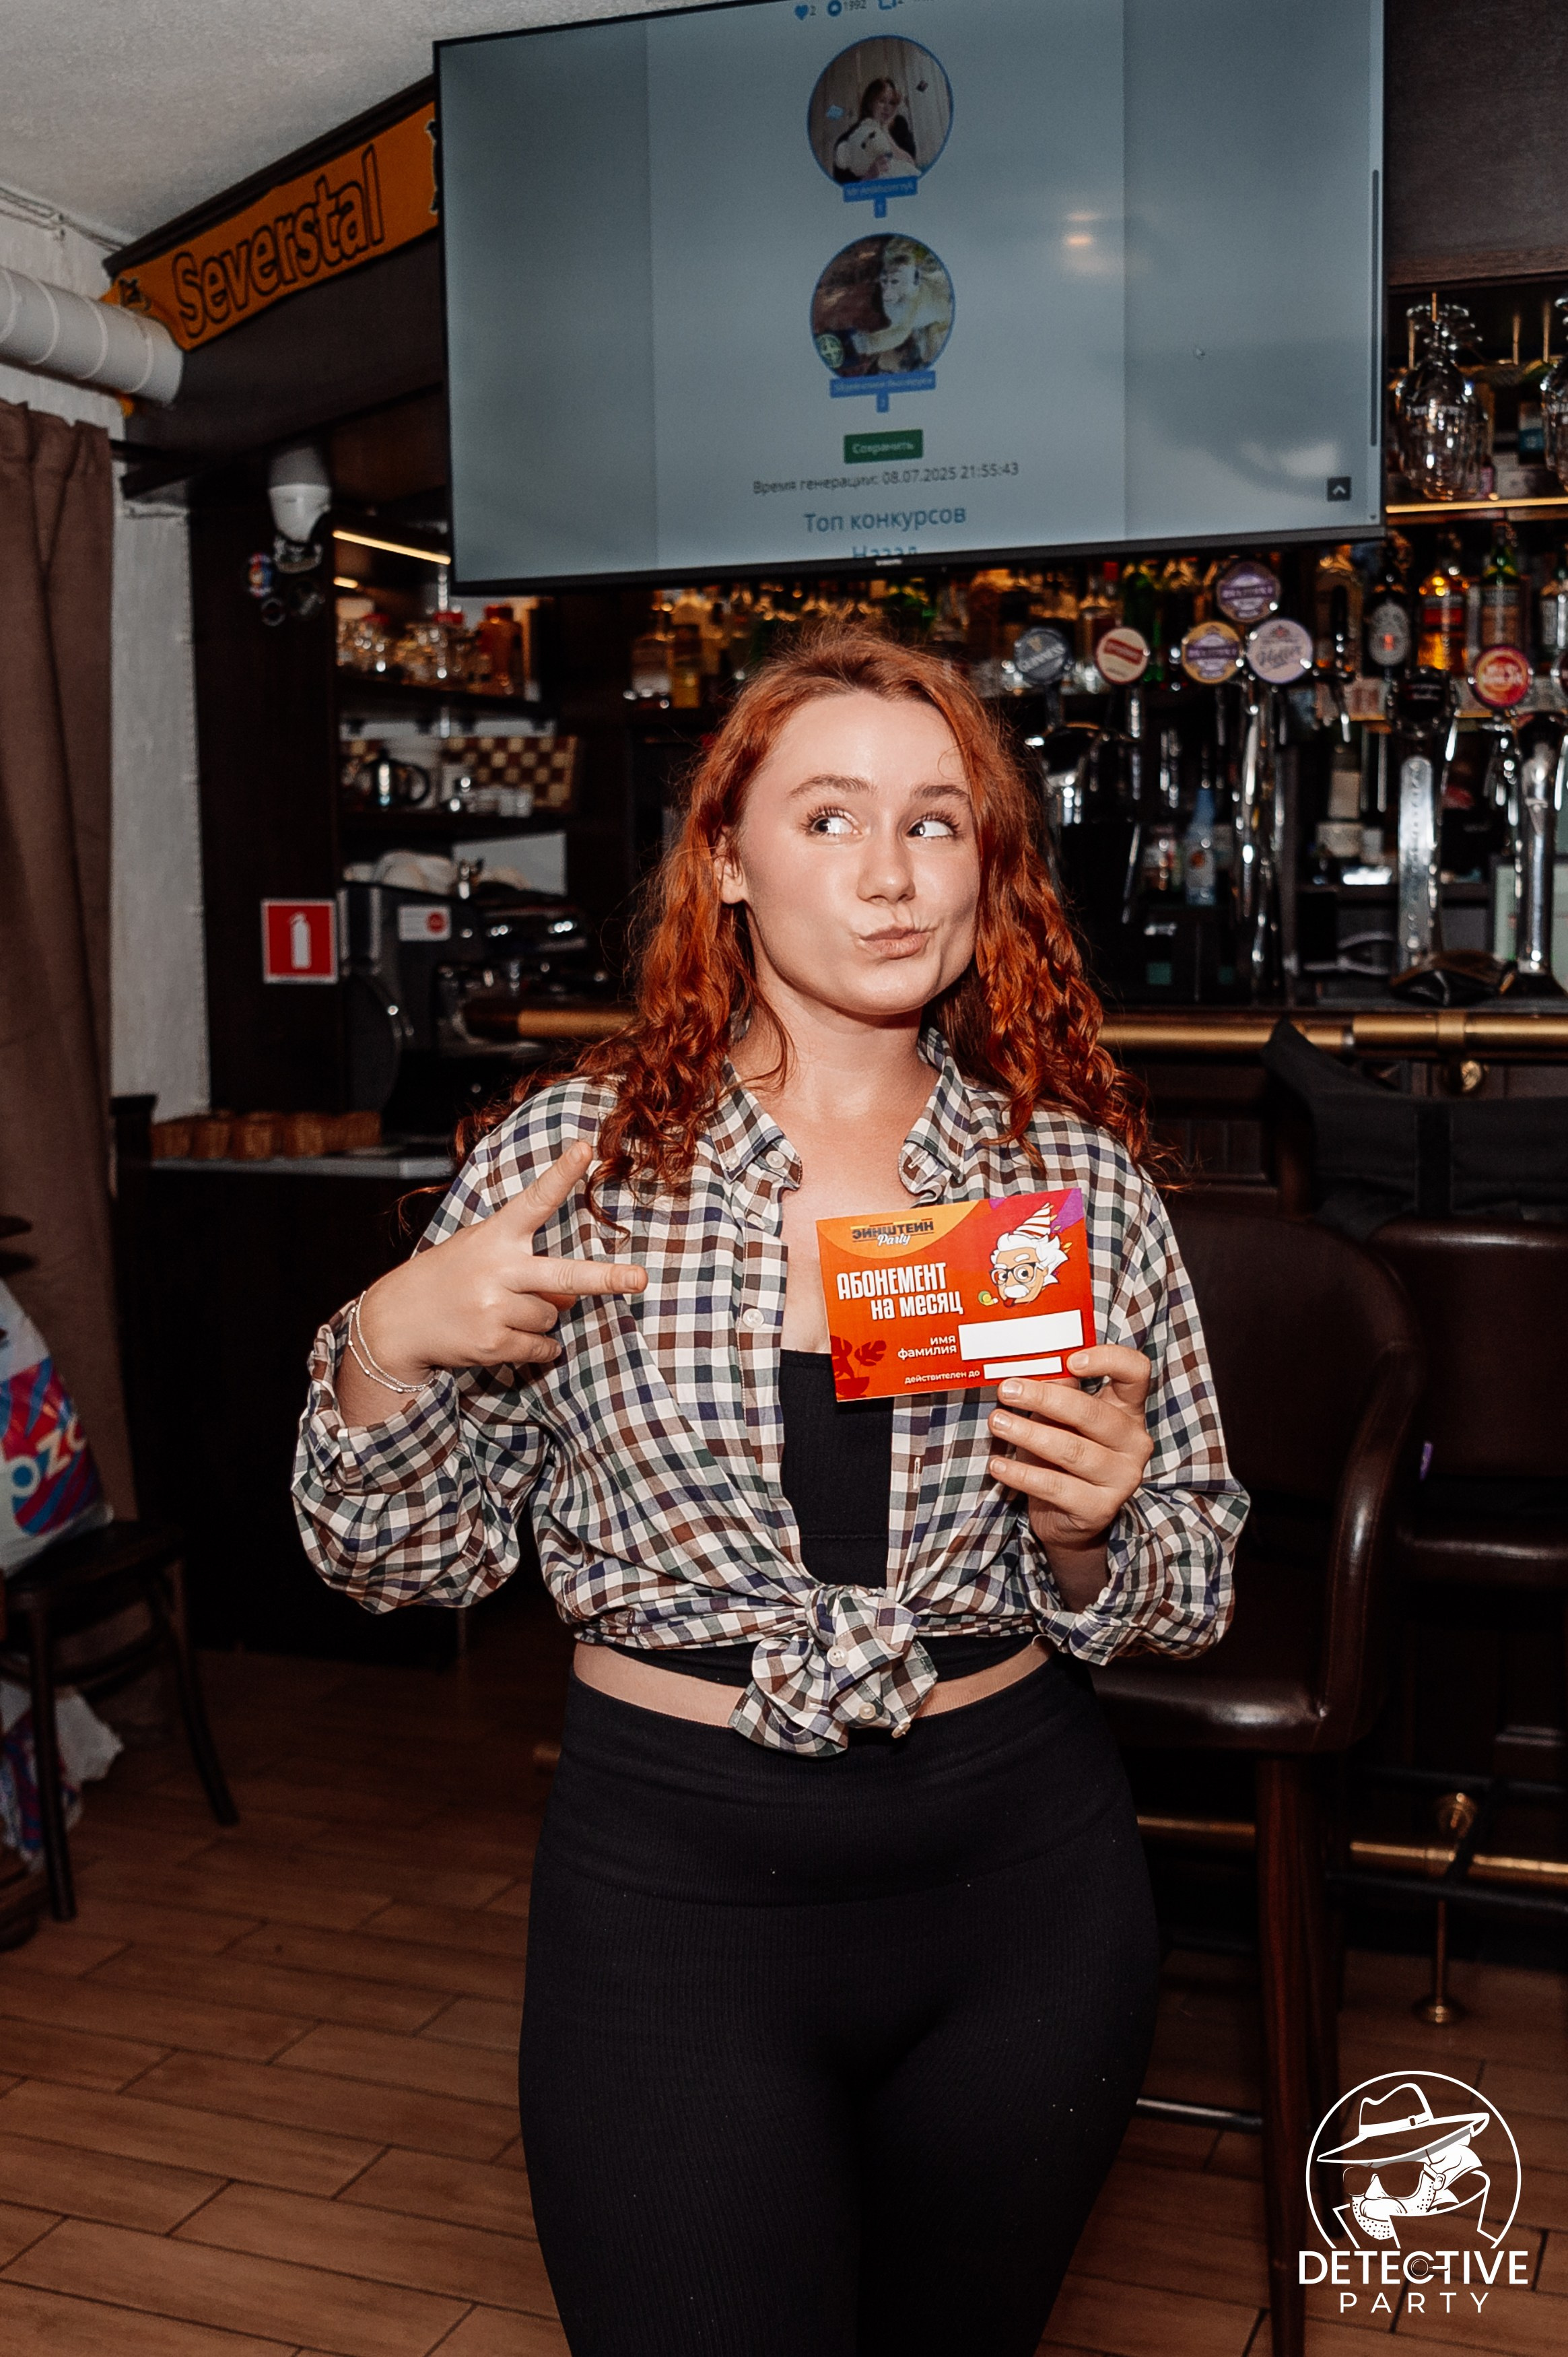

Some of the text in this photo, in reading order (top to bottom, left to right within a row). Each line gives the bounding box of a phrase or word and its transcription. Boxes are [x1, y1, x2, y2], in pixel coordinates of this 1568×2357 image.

[171, 142, 385, 338] Severstal
[753, 480, 796, 495] Время
[882, 466, 956, 485] 08.07.2025
[961, 461, 1019, 479] 21:55:43
[803, 507, 966, 533] Топ конкурсов
[877, 1233, 912, 1247] Party
[836, 1262, 947, 1300] АБОНЕМЕНТ
[930, 1335, 956, 1346] имя
[897, 1345, 957, 1361] фамилия
[904, 1370, 981, 1385] действителен до
